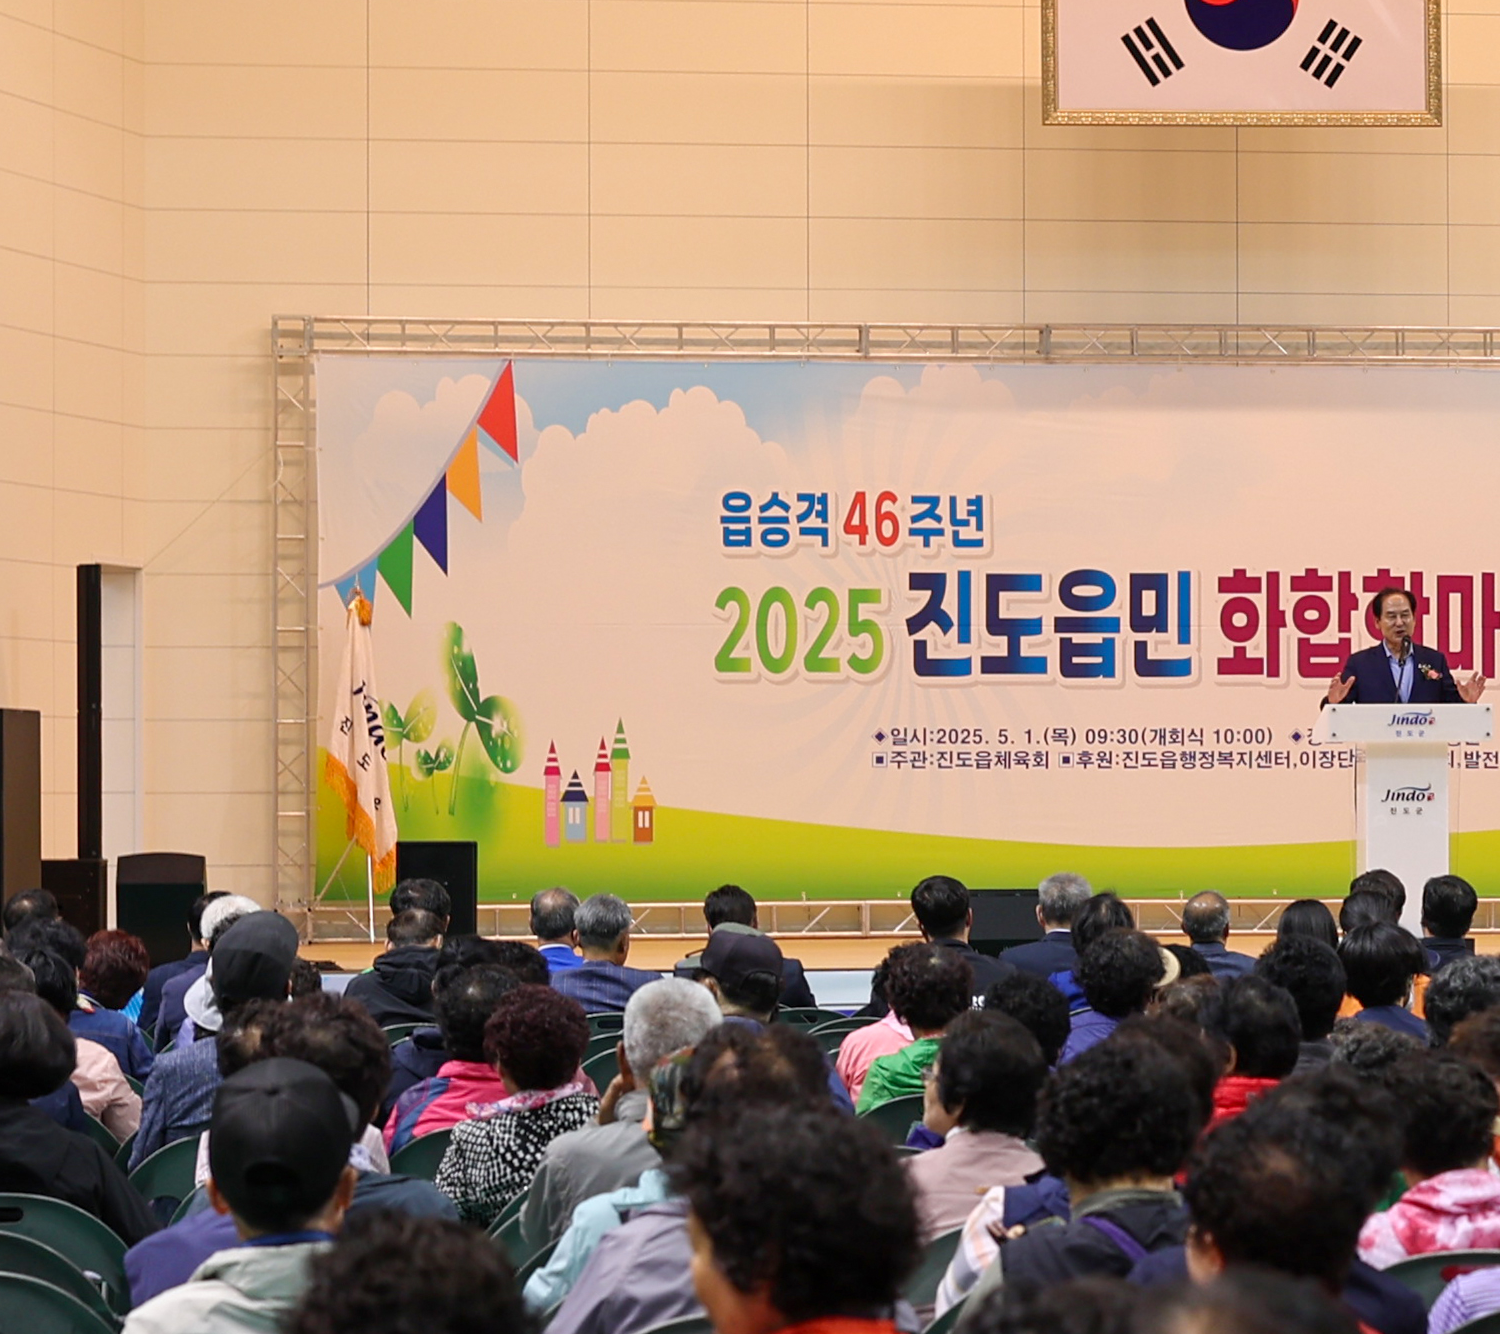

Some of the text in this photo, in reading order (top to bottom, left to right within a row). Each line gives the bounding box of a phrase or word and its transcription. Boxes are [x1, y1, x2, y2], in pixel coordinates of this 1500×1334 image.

[719, 490, 985, 549] 읍승격 46 주년
[713, 586, 886, 675] 2025
[904, 569, 1194, 679] 진도읍민
[1387, 712, 1429, 727] Jindo
[890, 727, 1274, 747] 일시:2025. 5. 1.(목) 09:30(개회식 10:00)
[1395, 729, 1426, 738] 진도군
[889, 750, 1050, 770] 주관:진도읍체육회
[1380, 788, 1427, 803] Jindo
[1390, 807, 1424, 816] 진도군
